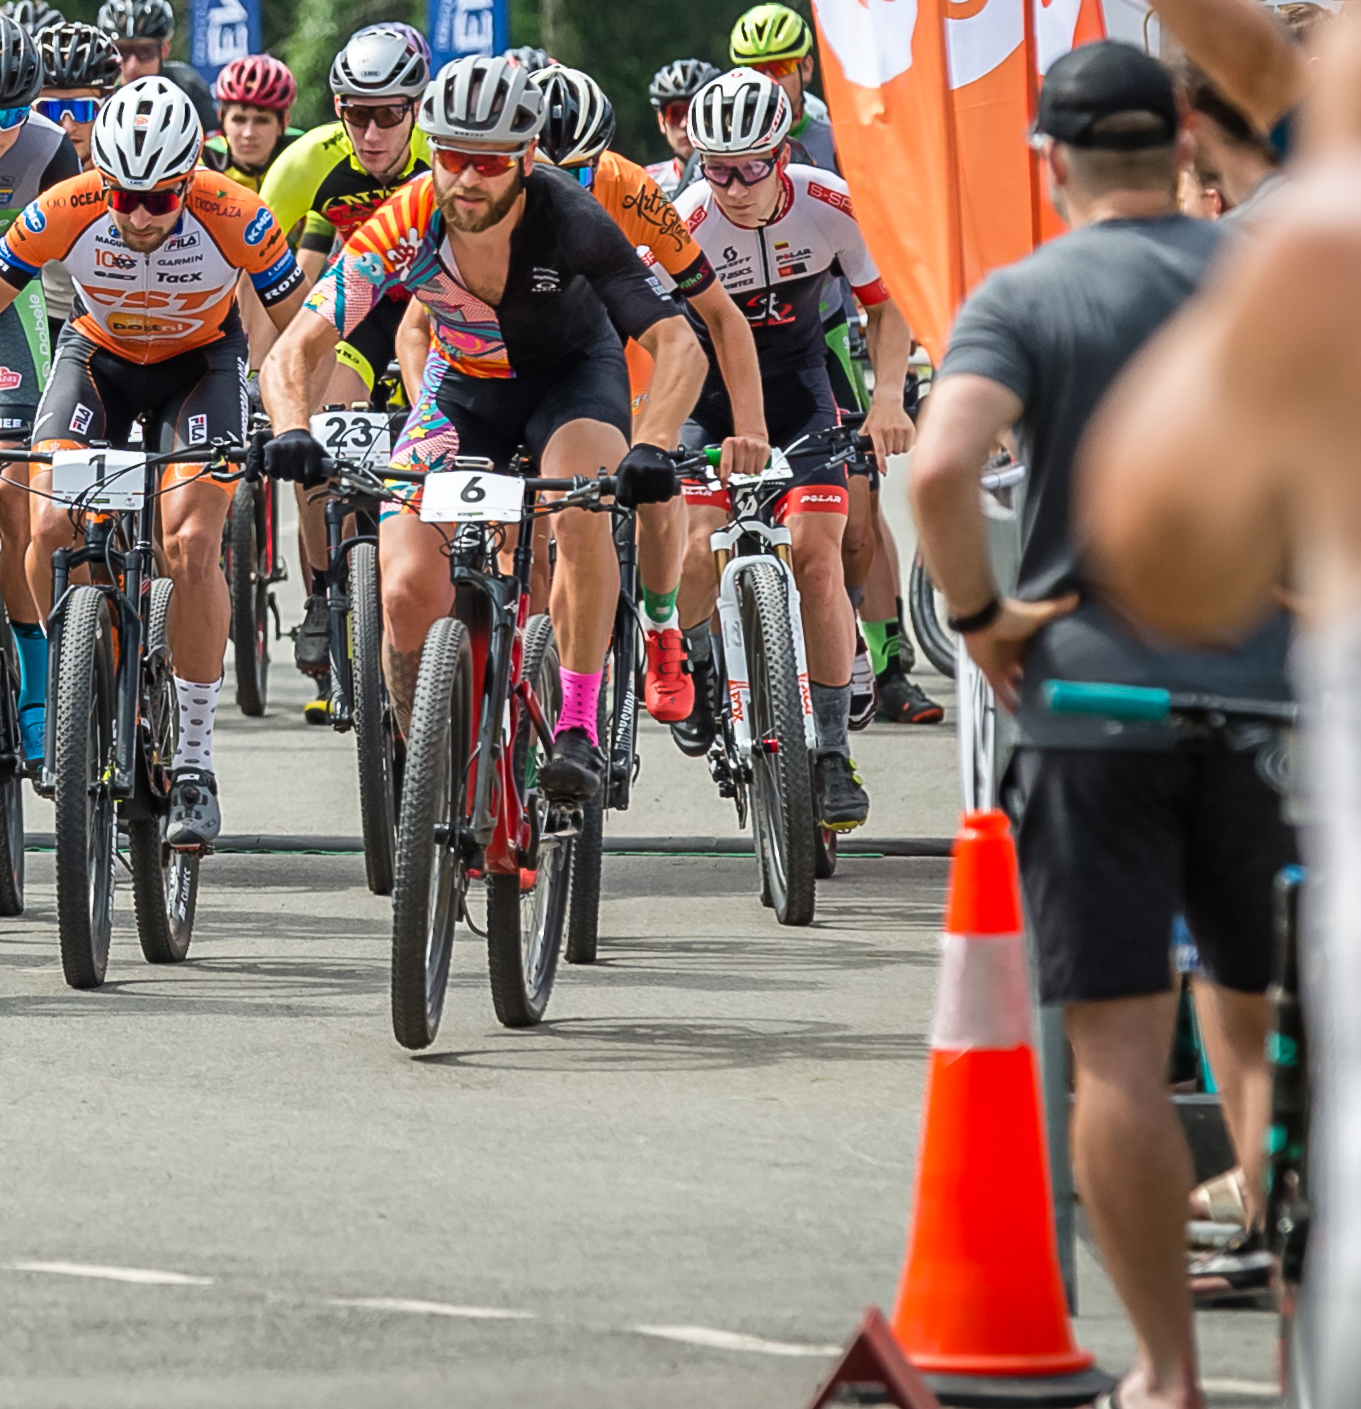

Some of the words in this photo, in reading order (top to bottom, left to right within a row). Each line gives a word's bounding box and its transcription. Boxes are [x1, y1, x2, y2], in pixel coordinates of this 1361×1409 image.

[94, 235, 128, 248] MAGU
[157, 254, 204, 266] GARMIN
[157, 272, 204, 284] Tacx
[325, 417, 375, 448] 23
[88, 454, 107, 488] 1
[460, 476, 486, 504] 6
